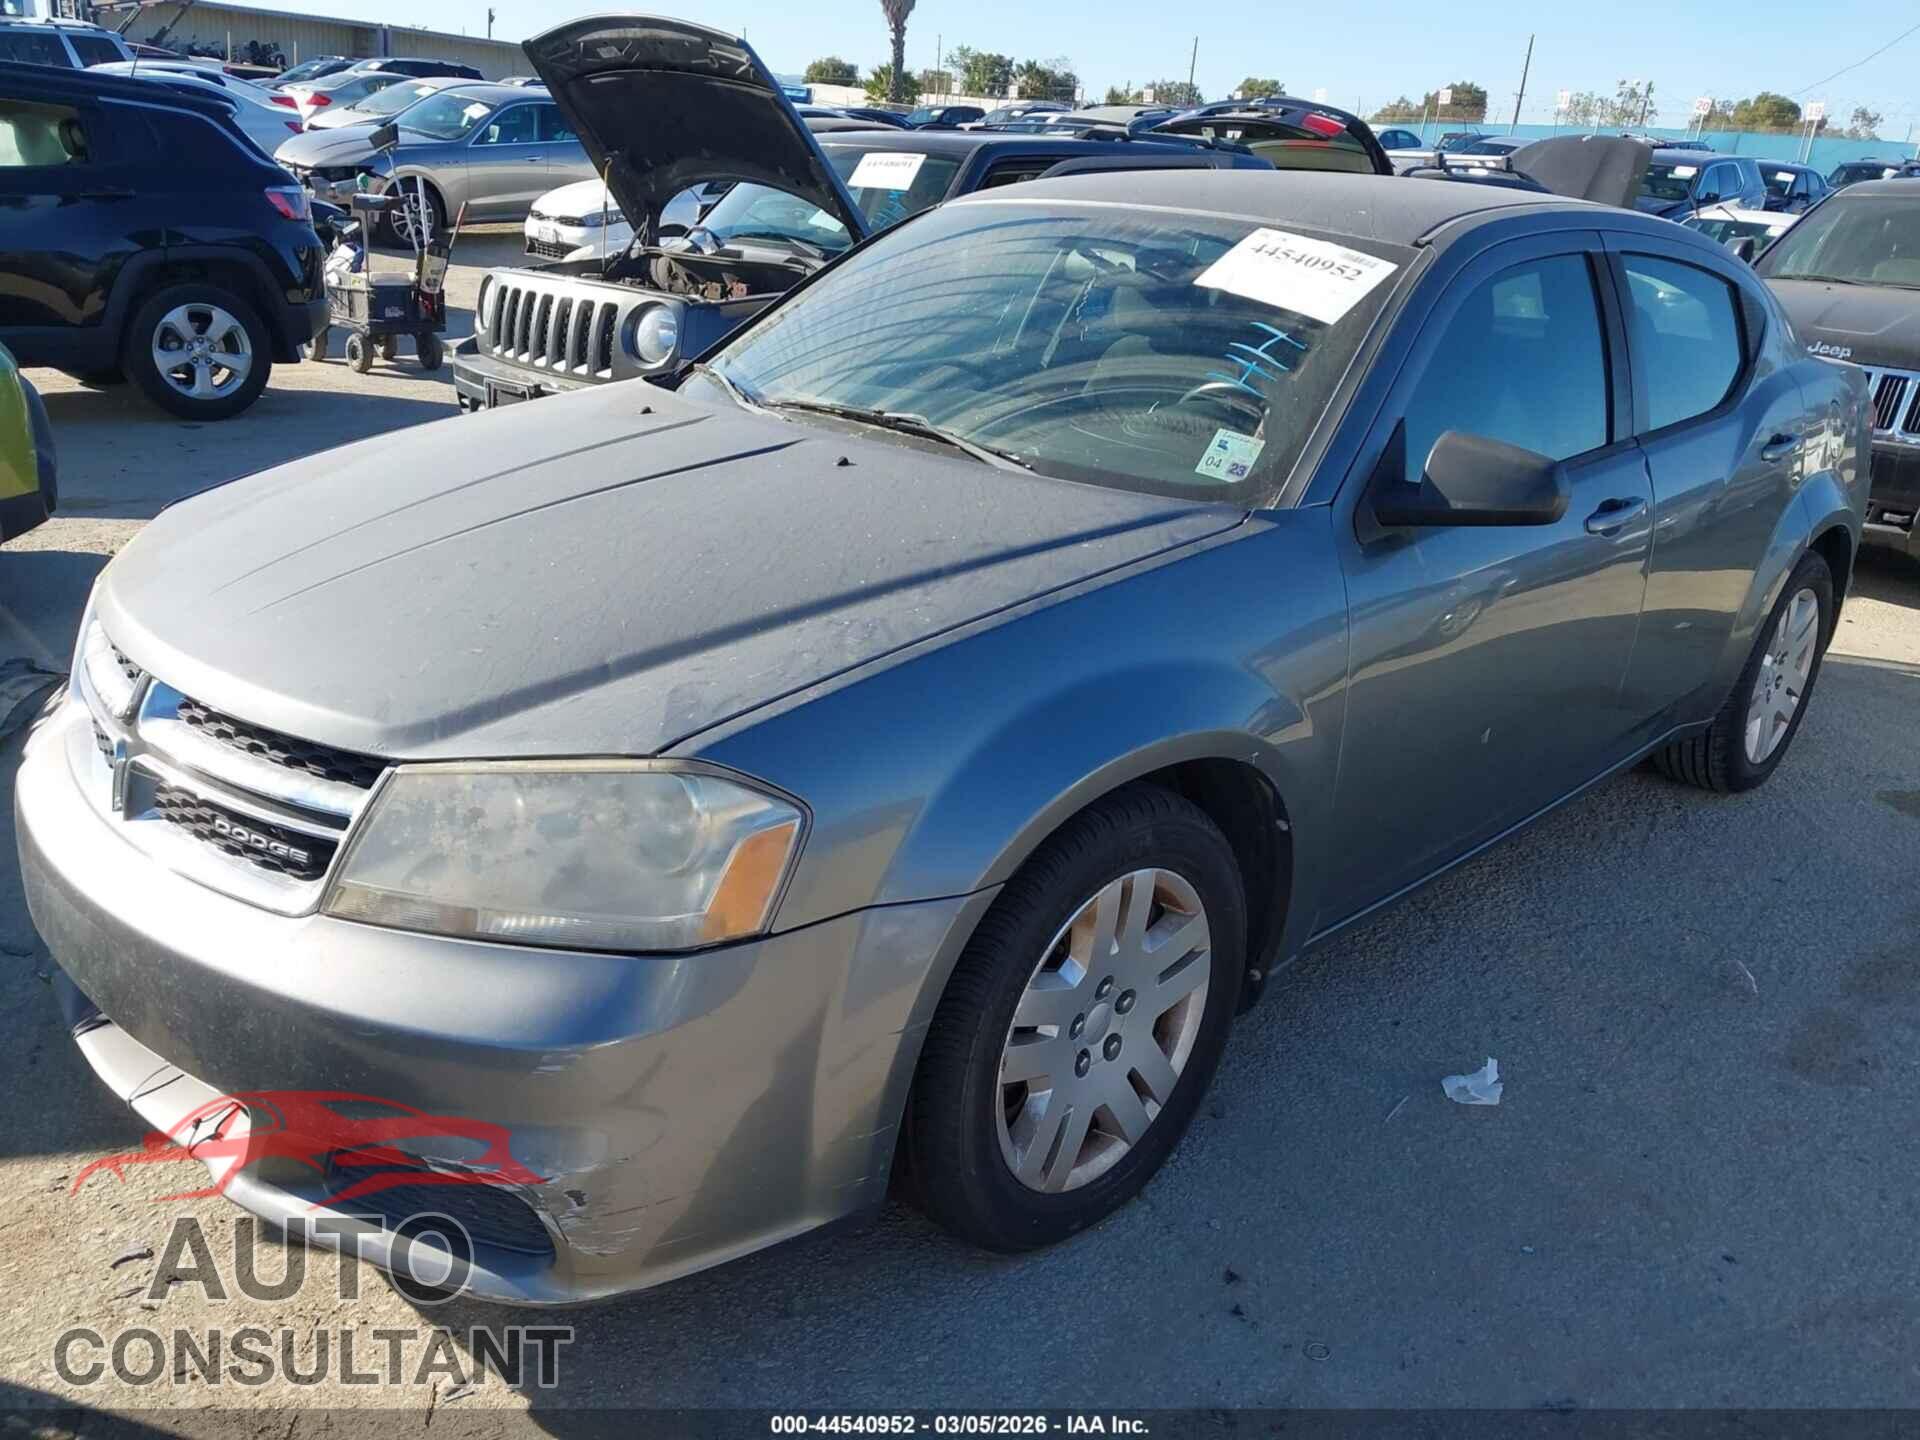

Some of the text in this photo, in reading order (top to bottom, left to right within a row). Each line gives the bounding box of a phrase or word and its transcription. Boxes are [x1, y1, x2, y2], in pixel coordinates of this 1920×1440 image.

[1251, 243, 1363, 281] 44540952
[1807, 340, 1852, 358] Jeep
[1205, 456, 1222, 468] 04
[1230, 463, 1247, 476] 23
[214, 819, 309, 863] DODGE
